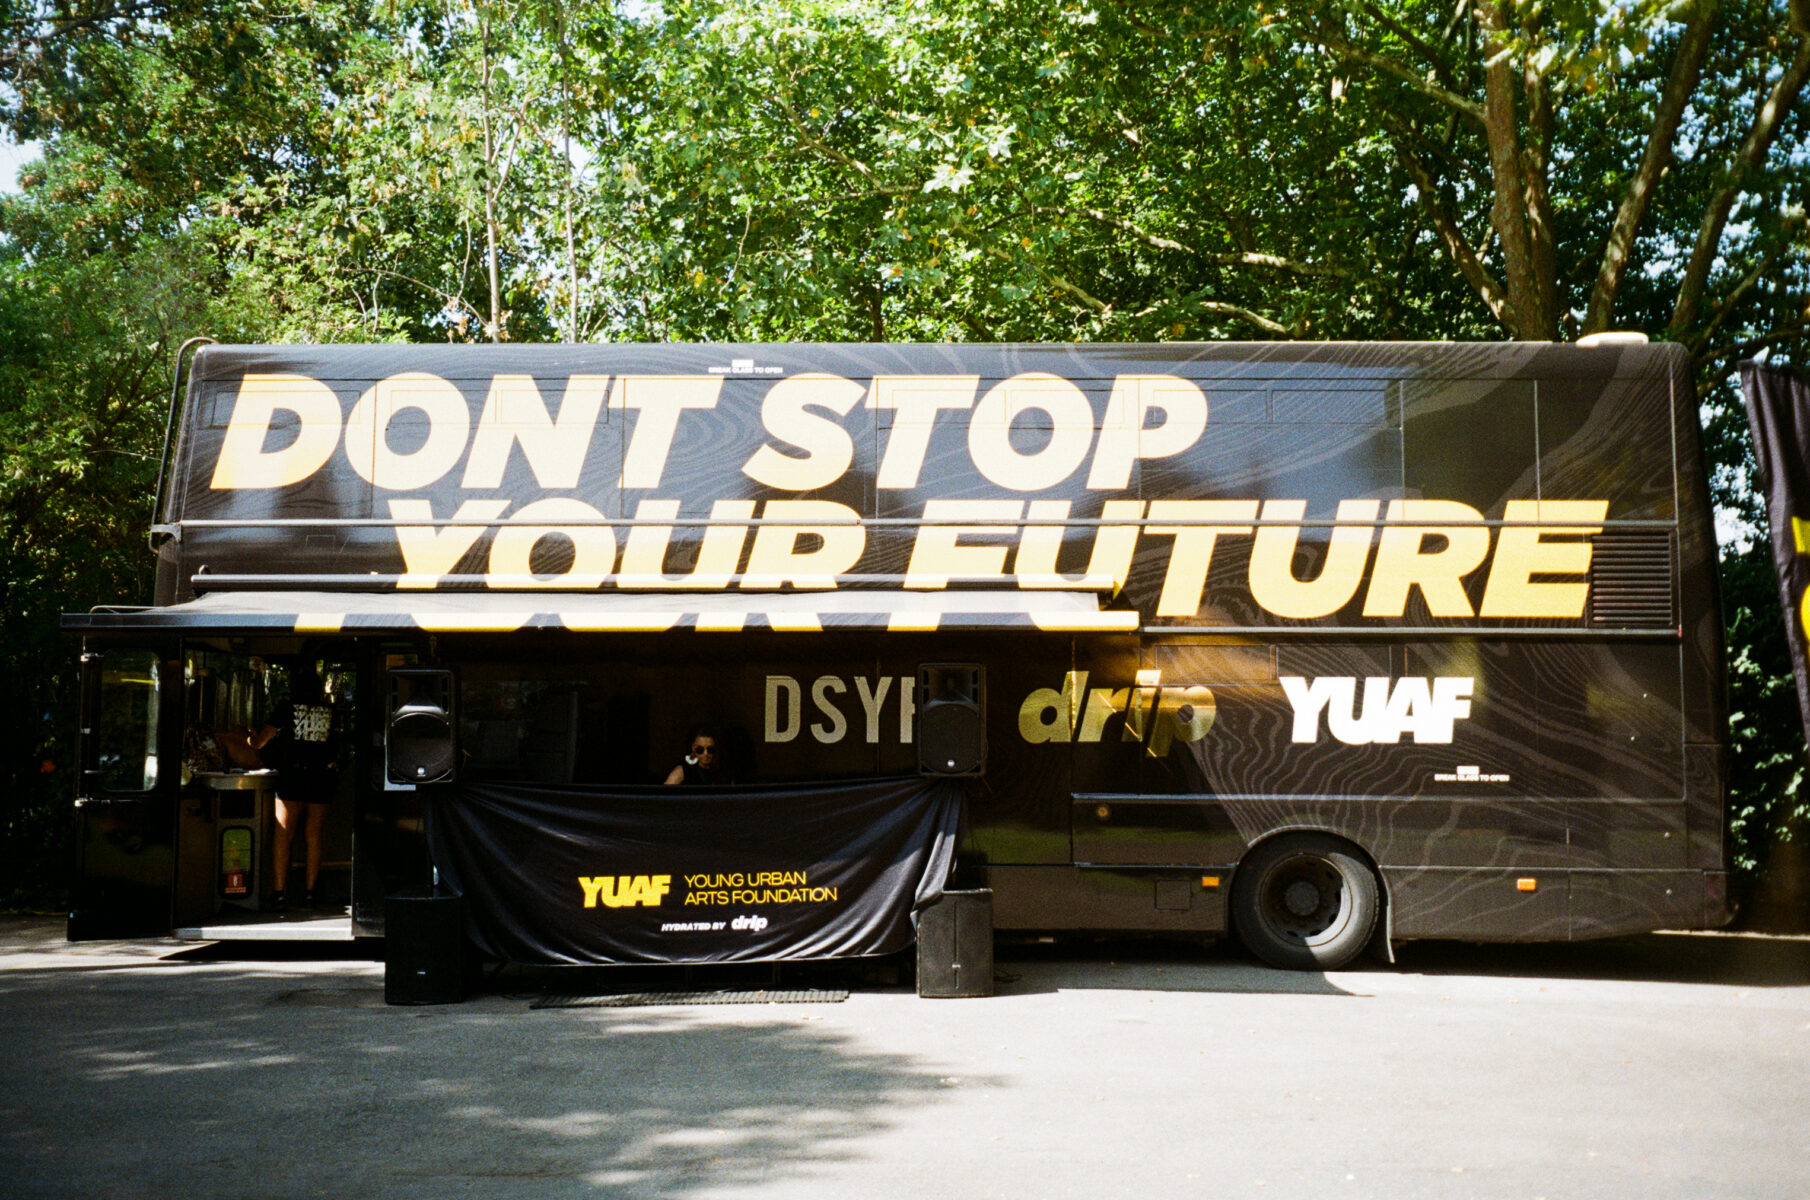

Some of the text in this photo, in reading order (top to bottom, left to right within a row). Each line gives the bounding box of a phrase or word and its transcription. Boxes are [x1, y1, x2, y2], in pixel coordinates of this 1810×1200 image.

[209, 372, 1208, 491] DONT STOP
[387, 498, 1609, 619] YOUR FUTURE
[1017, 669, 1218, 758] drip
[1279, 676, 1475, 745] YUAF
[1480, 774, 1490, 782] TO
[1490, 774, 1510, 782] OPEN
[578, 874, 672, 908] YUAF
[684, 871, 807, 888] YOUNG URBAN
[684, 887, 838, 906] ARTS FOUNDATION
[661, 922, 726, 932] HYDRATED BY
[731, 915, 768, 932] drip
